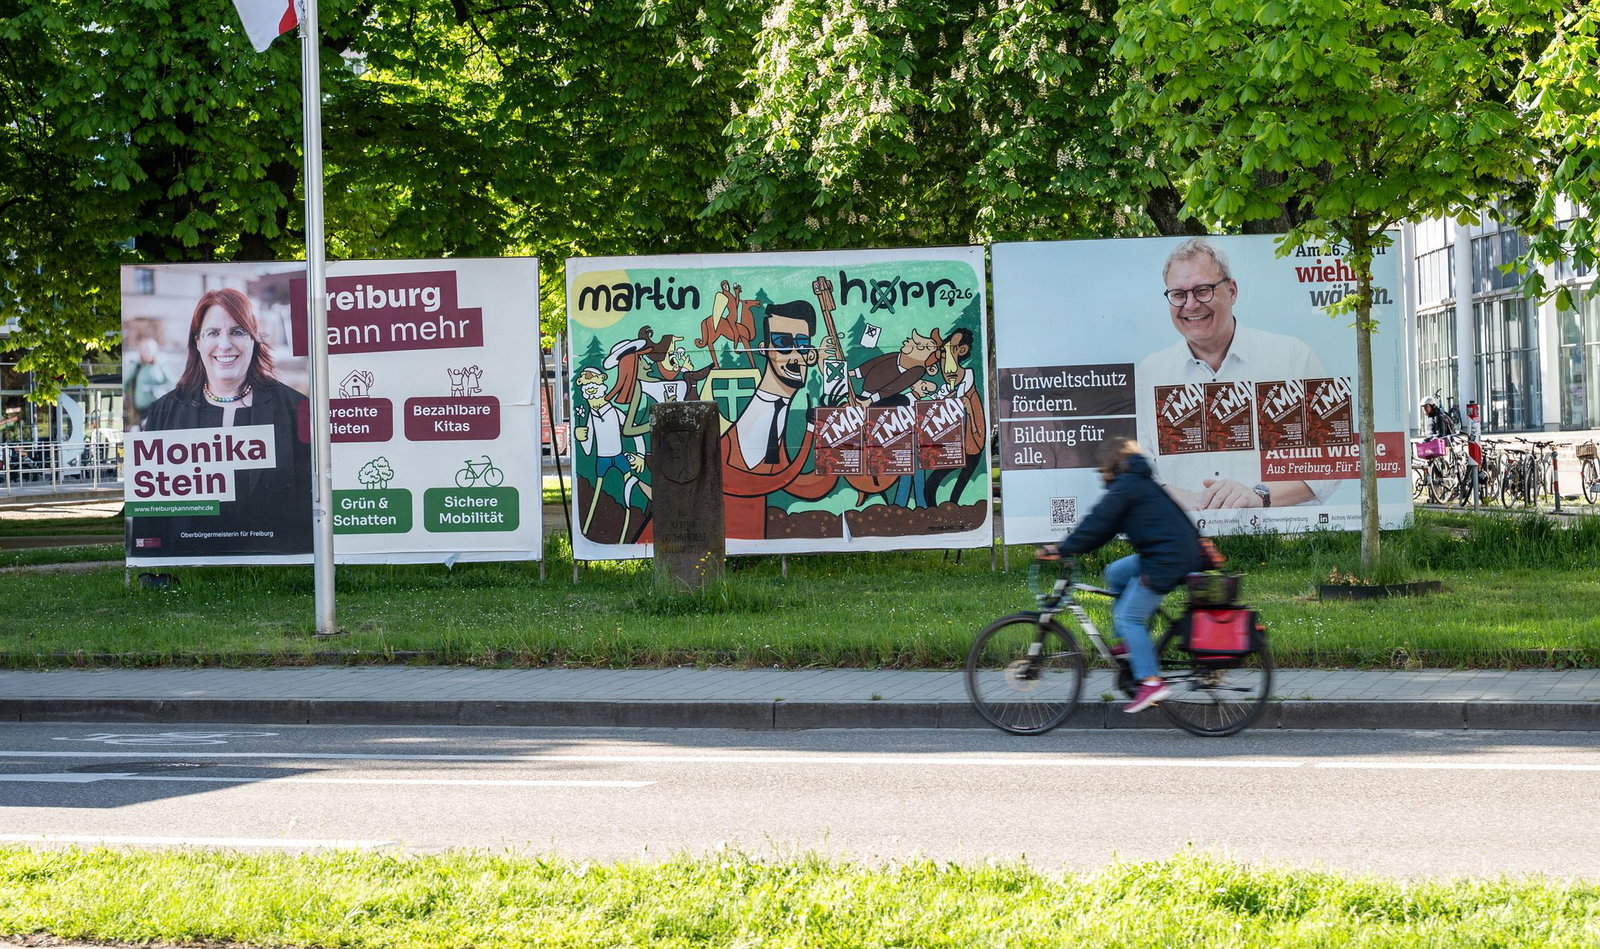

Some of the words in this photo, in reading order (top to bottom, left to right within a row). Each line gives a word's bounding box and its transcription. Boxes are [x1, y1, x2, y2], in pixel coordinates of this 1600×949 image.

[326, 284, 441, 312] reiburg
[578, 276, 700, 313] martin
[940, 287, 973, 301] 2026
[1309, 282, 1394, 307] wähn.
[327, 324, 381, 346] ann
[390, 315, 470, 342] mehr
[1011, 370, 1127, 391] Umweltschutz
[413, 404, 491, 417] Bezahlbare
[1012, 395, 1078, 413] fördern.
[329, 406, 378, 418] rechte
[330, 422, 370, 434] ieten
[434, 420, 470, 432] Kitas
[1013, 425, 1076, 446] Bildung
[1079, 424, 1105, 442] für
[133, 434, 267, 467] Monika
[1014, 447, 1047, 465] alle.
[1266, 463, 1286, 474] Aus
[1287, 462, 1334, 475] Freiburg.
[1335, 461, 1353, 473] Für
[1354, 460, 1401, 473] Fburg.
[134, 466, 227, 498] Stein
[134, 504, 214, 513] www.freiburgkannmehr.de
[341, 498, 376, 510] Grün
[378, 497, 389, 509] &
[444, 496, 498, 508] Sichere
[333, 514, 397, 526] Schatten
[439, 512, 504, 525] Mobilität
[180, 531, 239, 539] Oberbürgermeisterin
[240, 530, 249, 538] für
[249, 530, 274, 538] Freiburg
